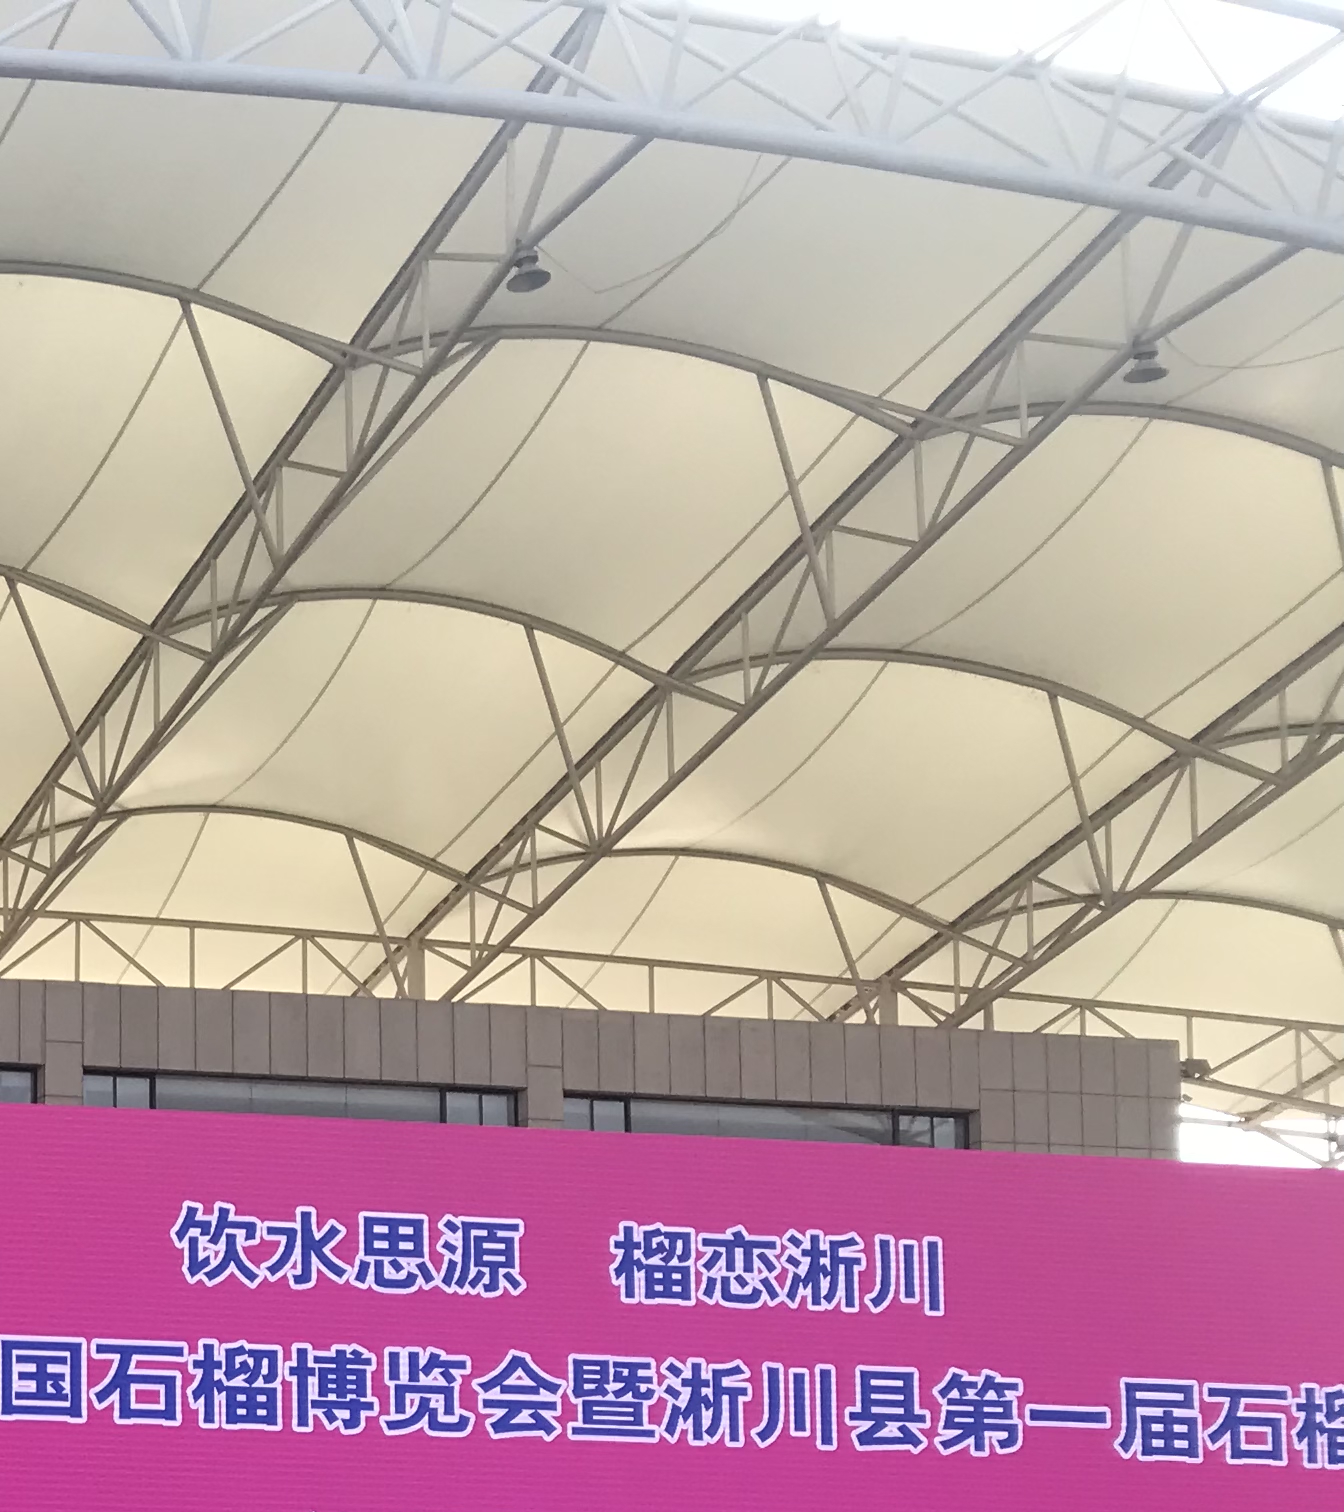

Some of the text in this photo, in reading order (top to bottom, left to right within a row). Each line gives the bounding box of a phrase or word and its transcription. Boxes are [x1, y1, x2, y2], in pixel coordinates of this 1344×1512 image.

[173, 1202, 944, 1316] 饮水思源 榴恋淅川
